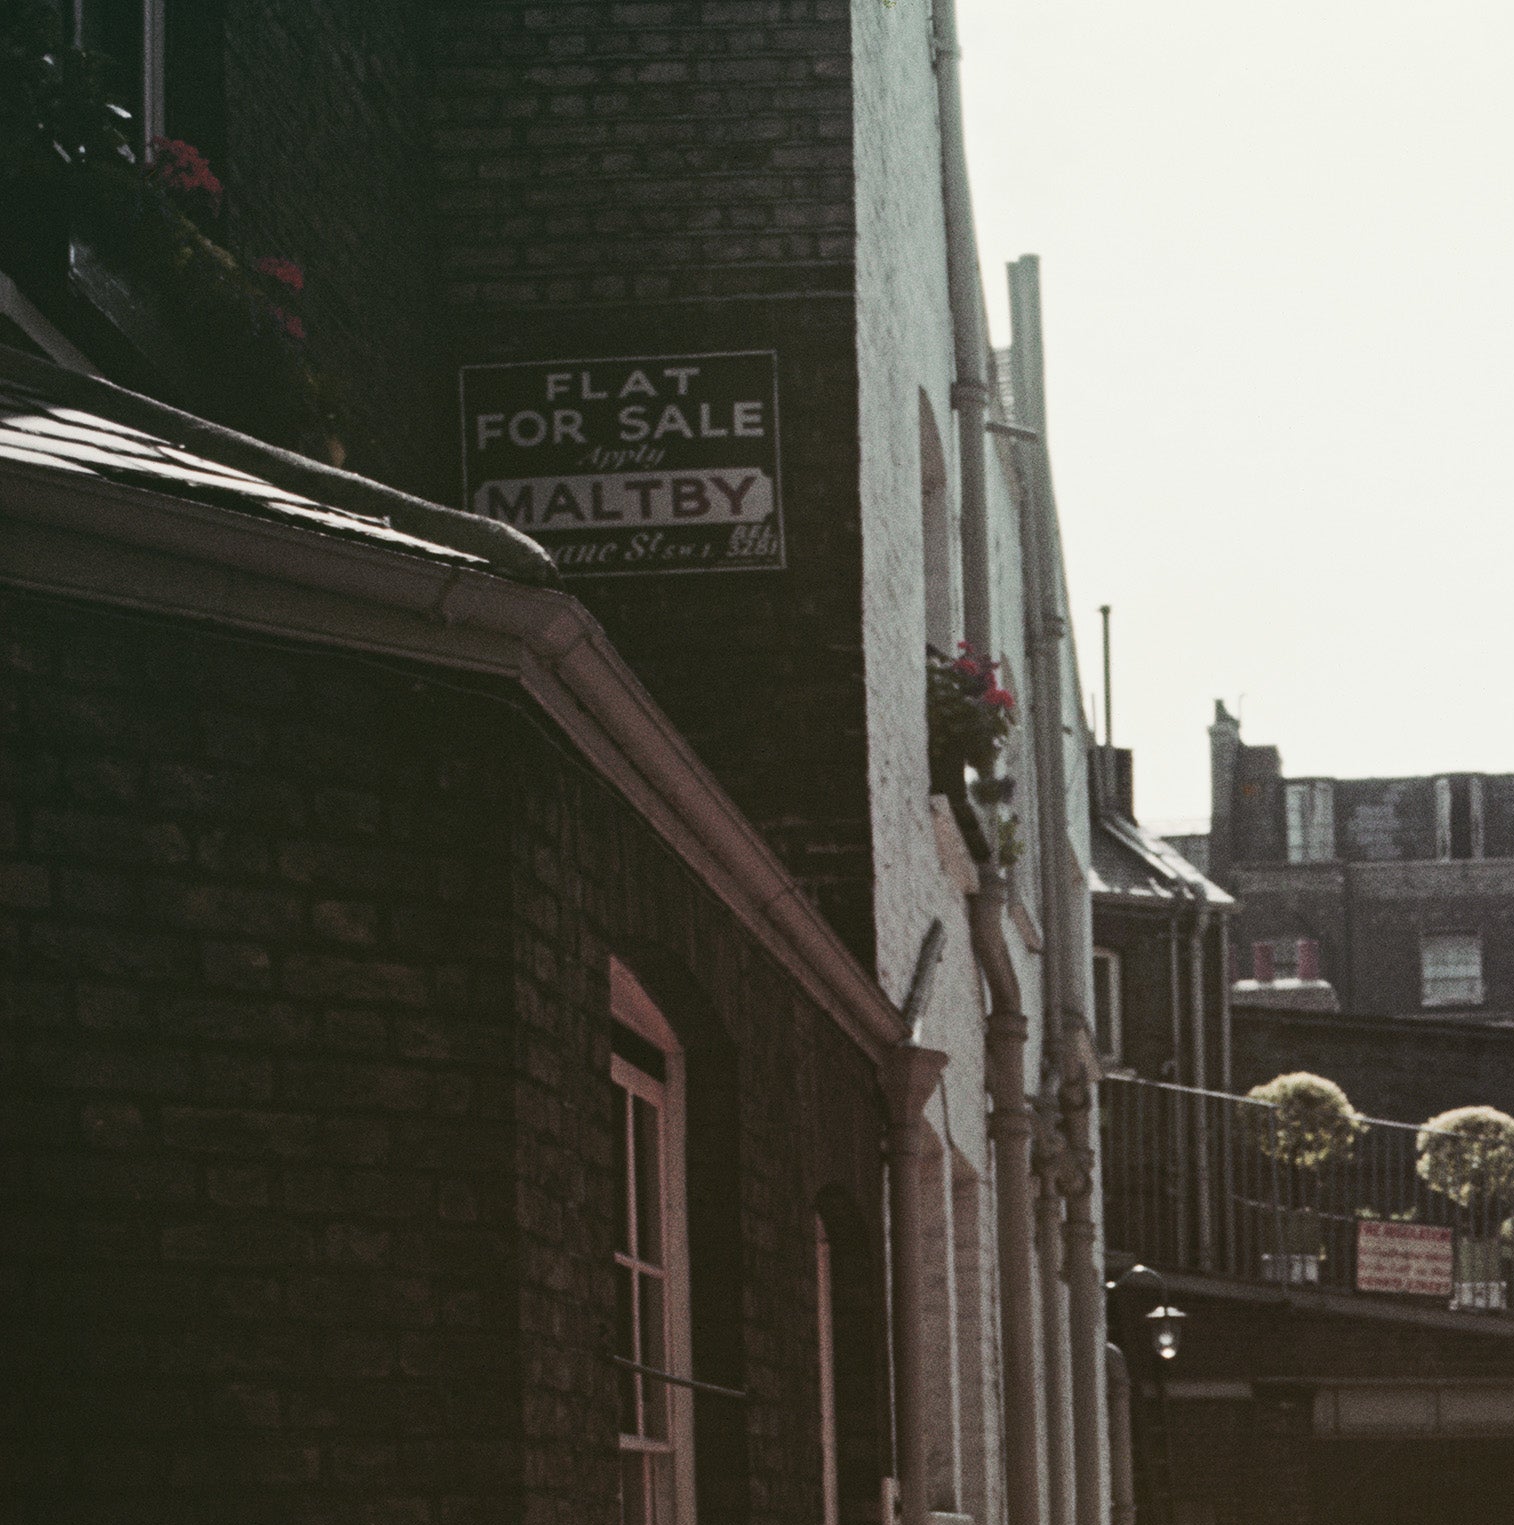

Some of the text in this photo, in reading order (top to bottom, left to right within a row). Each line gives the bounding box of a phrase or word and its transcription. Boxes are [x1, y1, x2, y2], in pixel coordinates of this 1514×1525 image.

[546, 366, 701, 400] FLAT
[476, 401, 765, 450] FOR SALE
[577, 443, 668, 470] Apply
[487, 474, 758, 525] MALTBY
